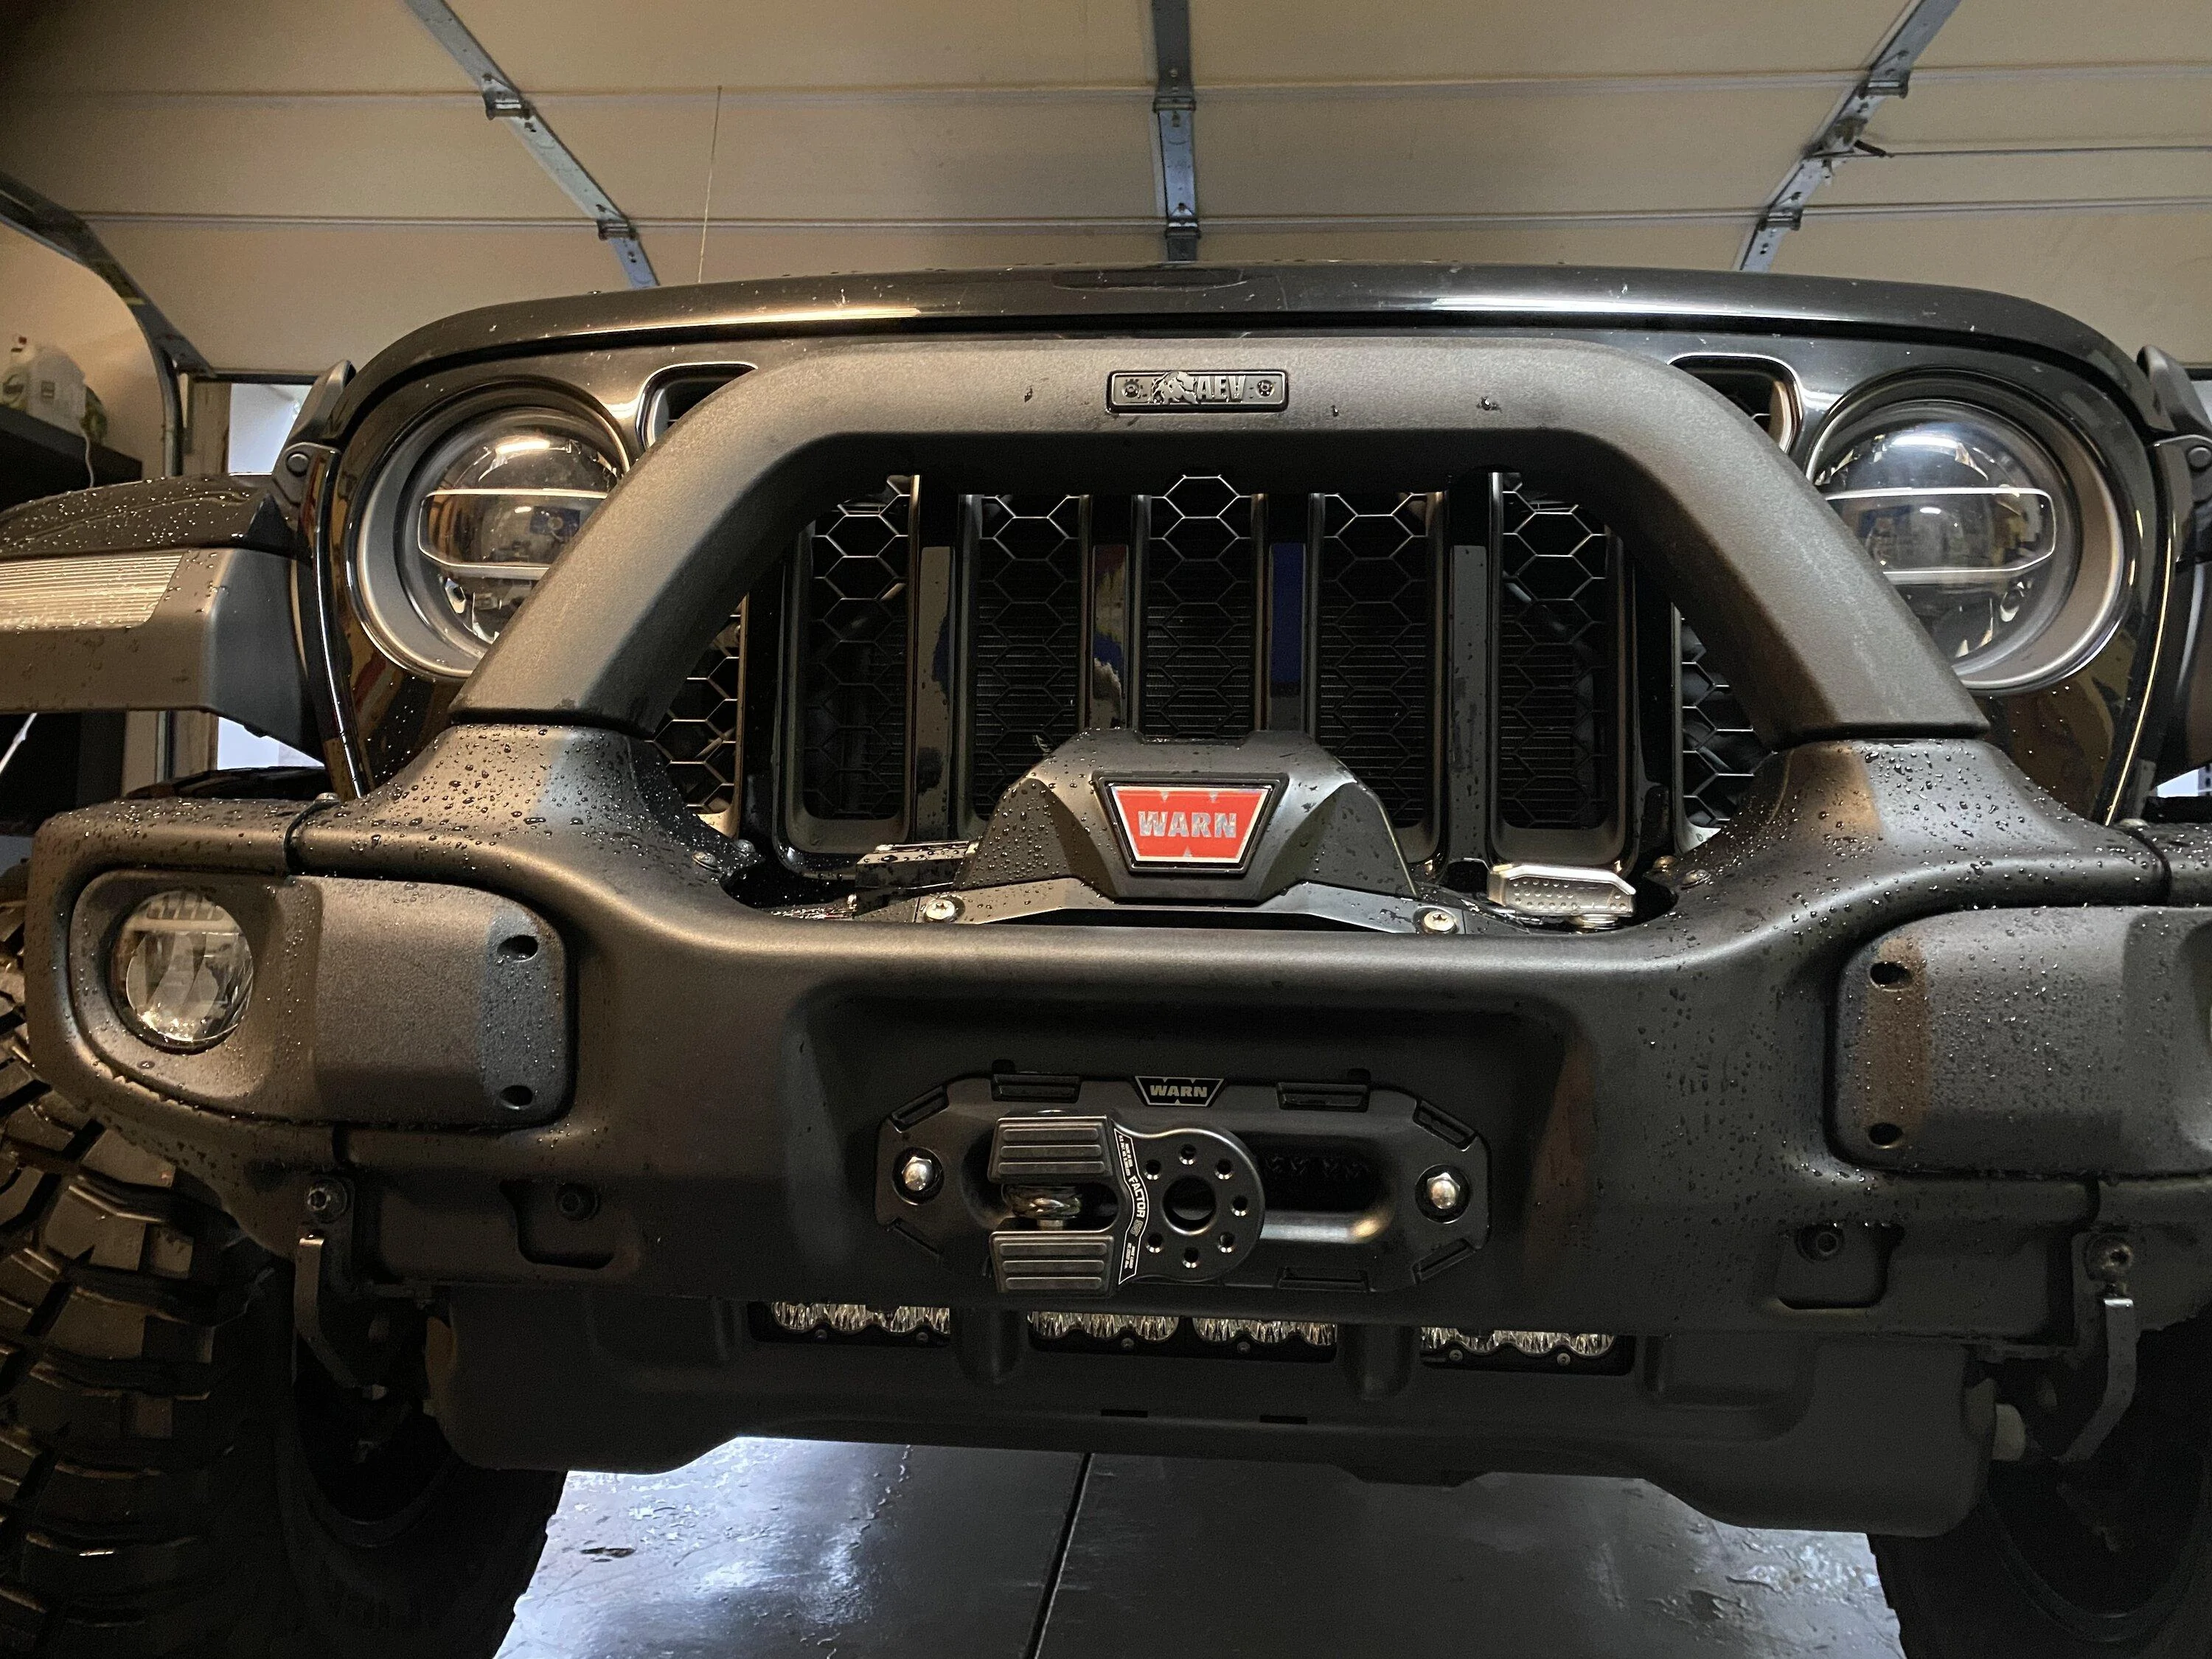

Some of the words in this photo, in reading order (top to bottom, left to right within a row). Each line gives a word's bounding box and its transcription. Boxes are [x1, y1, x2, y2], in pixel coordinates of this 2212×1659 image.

[1196, 375, 1247, 402] AEV
[1137, 810, 1238, 838] WARN
[1150, 1085, 1208, 1098] WARN
[1128, 1175, 1147, 1218] FACTOR
[1130, 1219, 1144, 1237] 55
